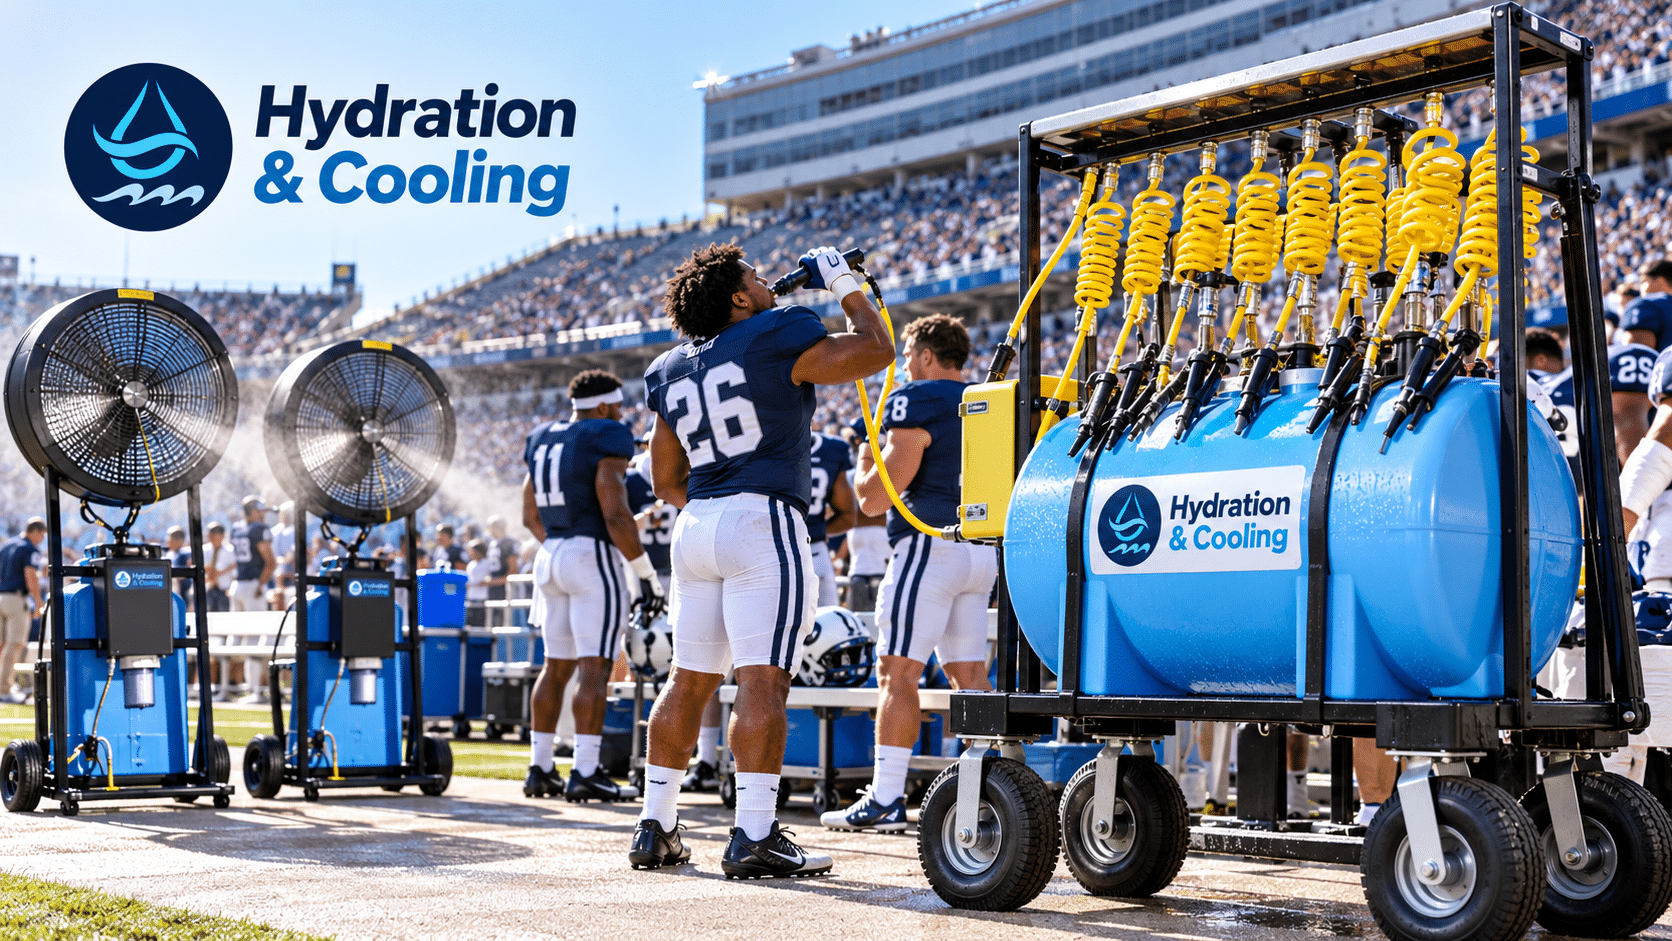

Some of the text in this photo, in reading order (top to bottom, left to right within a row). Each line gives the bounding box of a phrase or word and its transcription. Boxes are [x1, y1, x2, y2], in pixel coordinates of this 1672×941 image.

[665, 360, 764, 468] 26
[891, 396, 909, 422] 8
[533, 443, 566, 508] 11
[1170, 490, 1291, 525] Hydration
[1169, 522, 1289, 554] & Cooling
